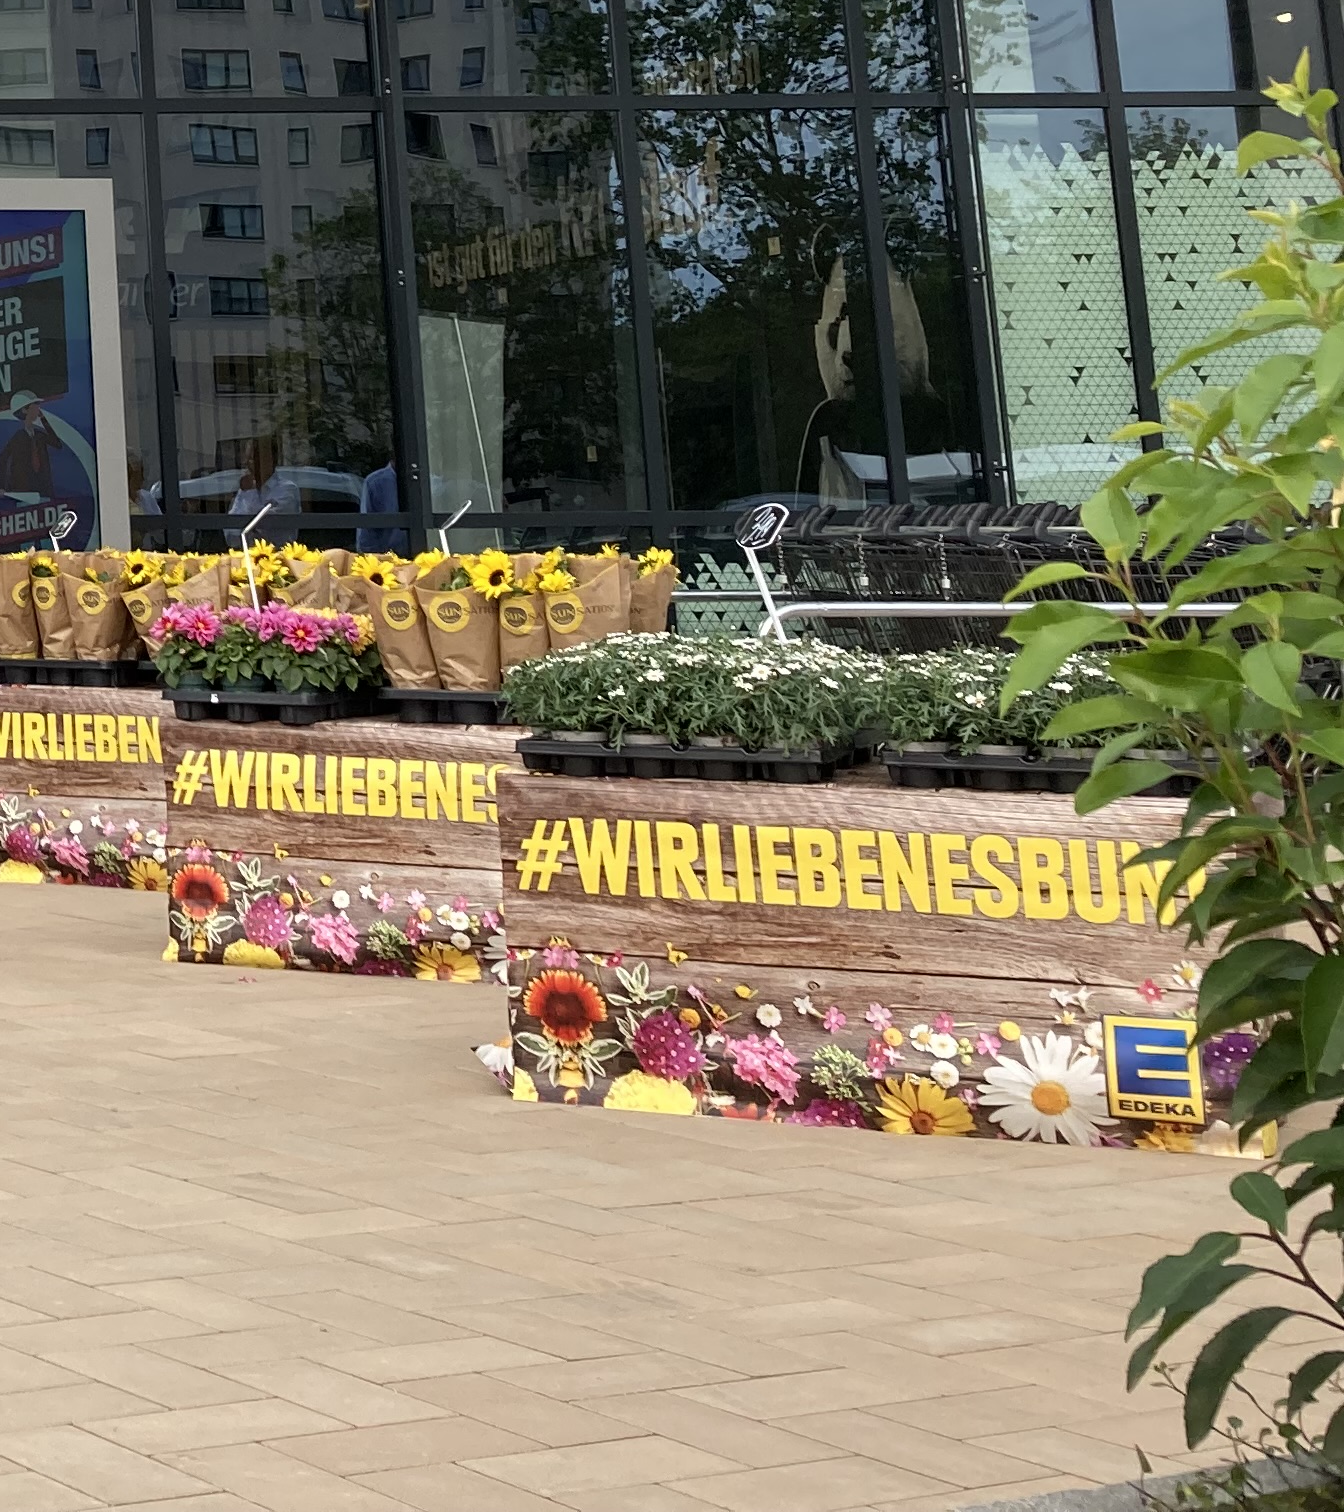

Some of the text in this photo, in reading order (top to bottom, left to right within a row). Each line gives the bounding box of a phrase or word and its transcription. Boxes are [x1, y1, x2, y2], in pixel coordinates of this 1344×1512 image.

[550, 607, 575, 620] SUN
[516, 817, 1207, 926] #WIRLIEBENESBUN
[1114, 1026, 1192, 1097] E
[1118, 1099, 1197, 1117] EDEKA
